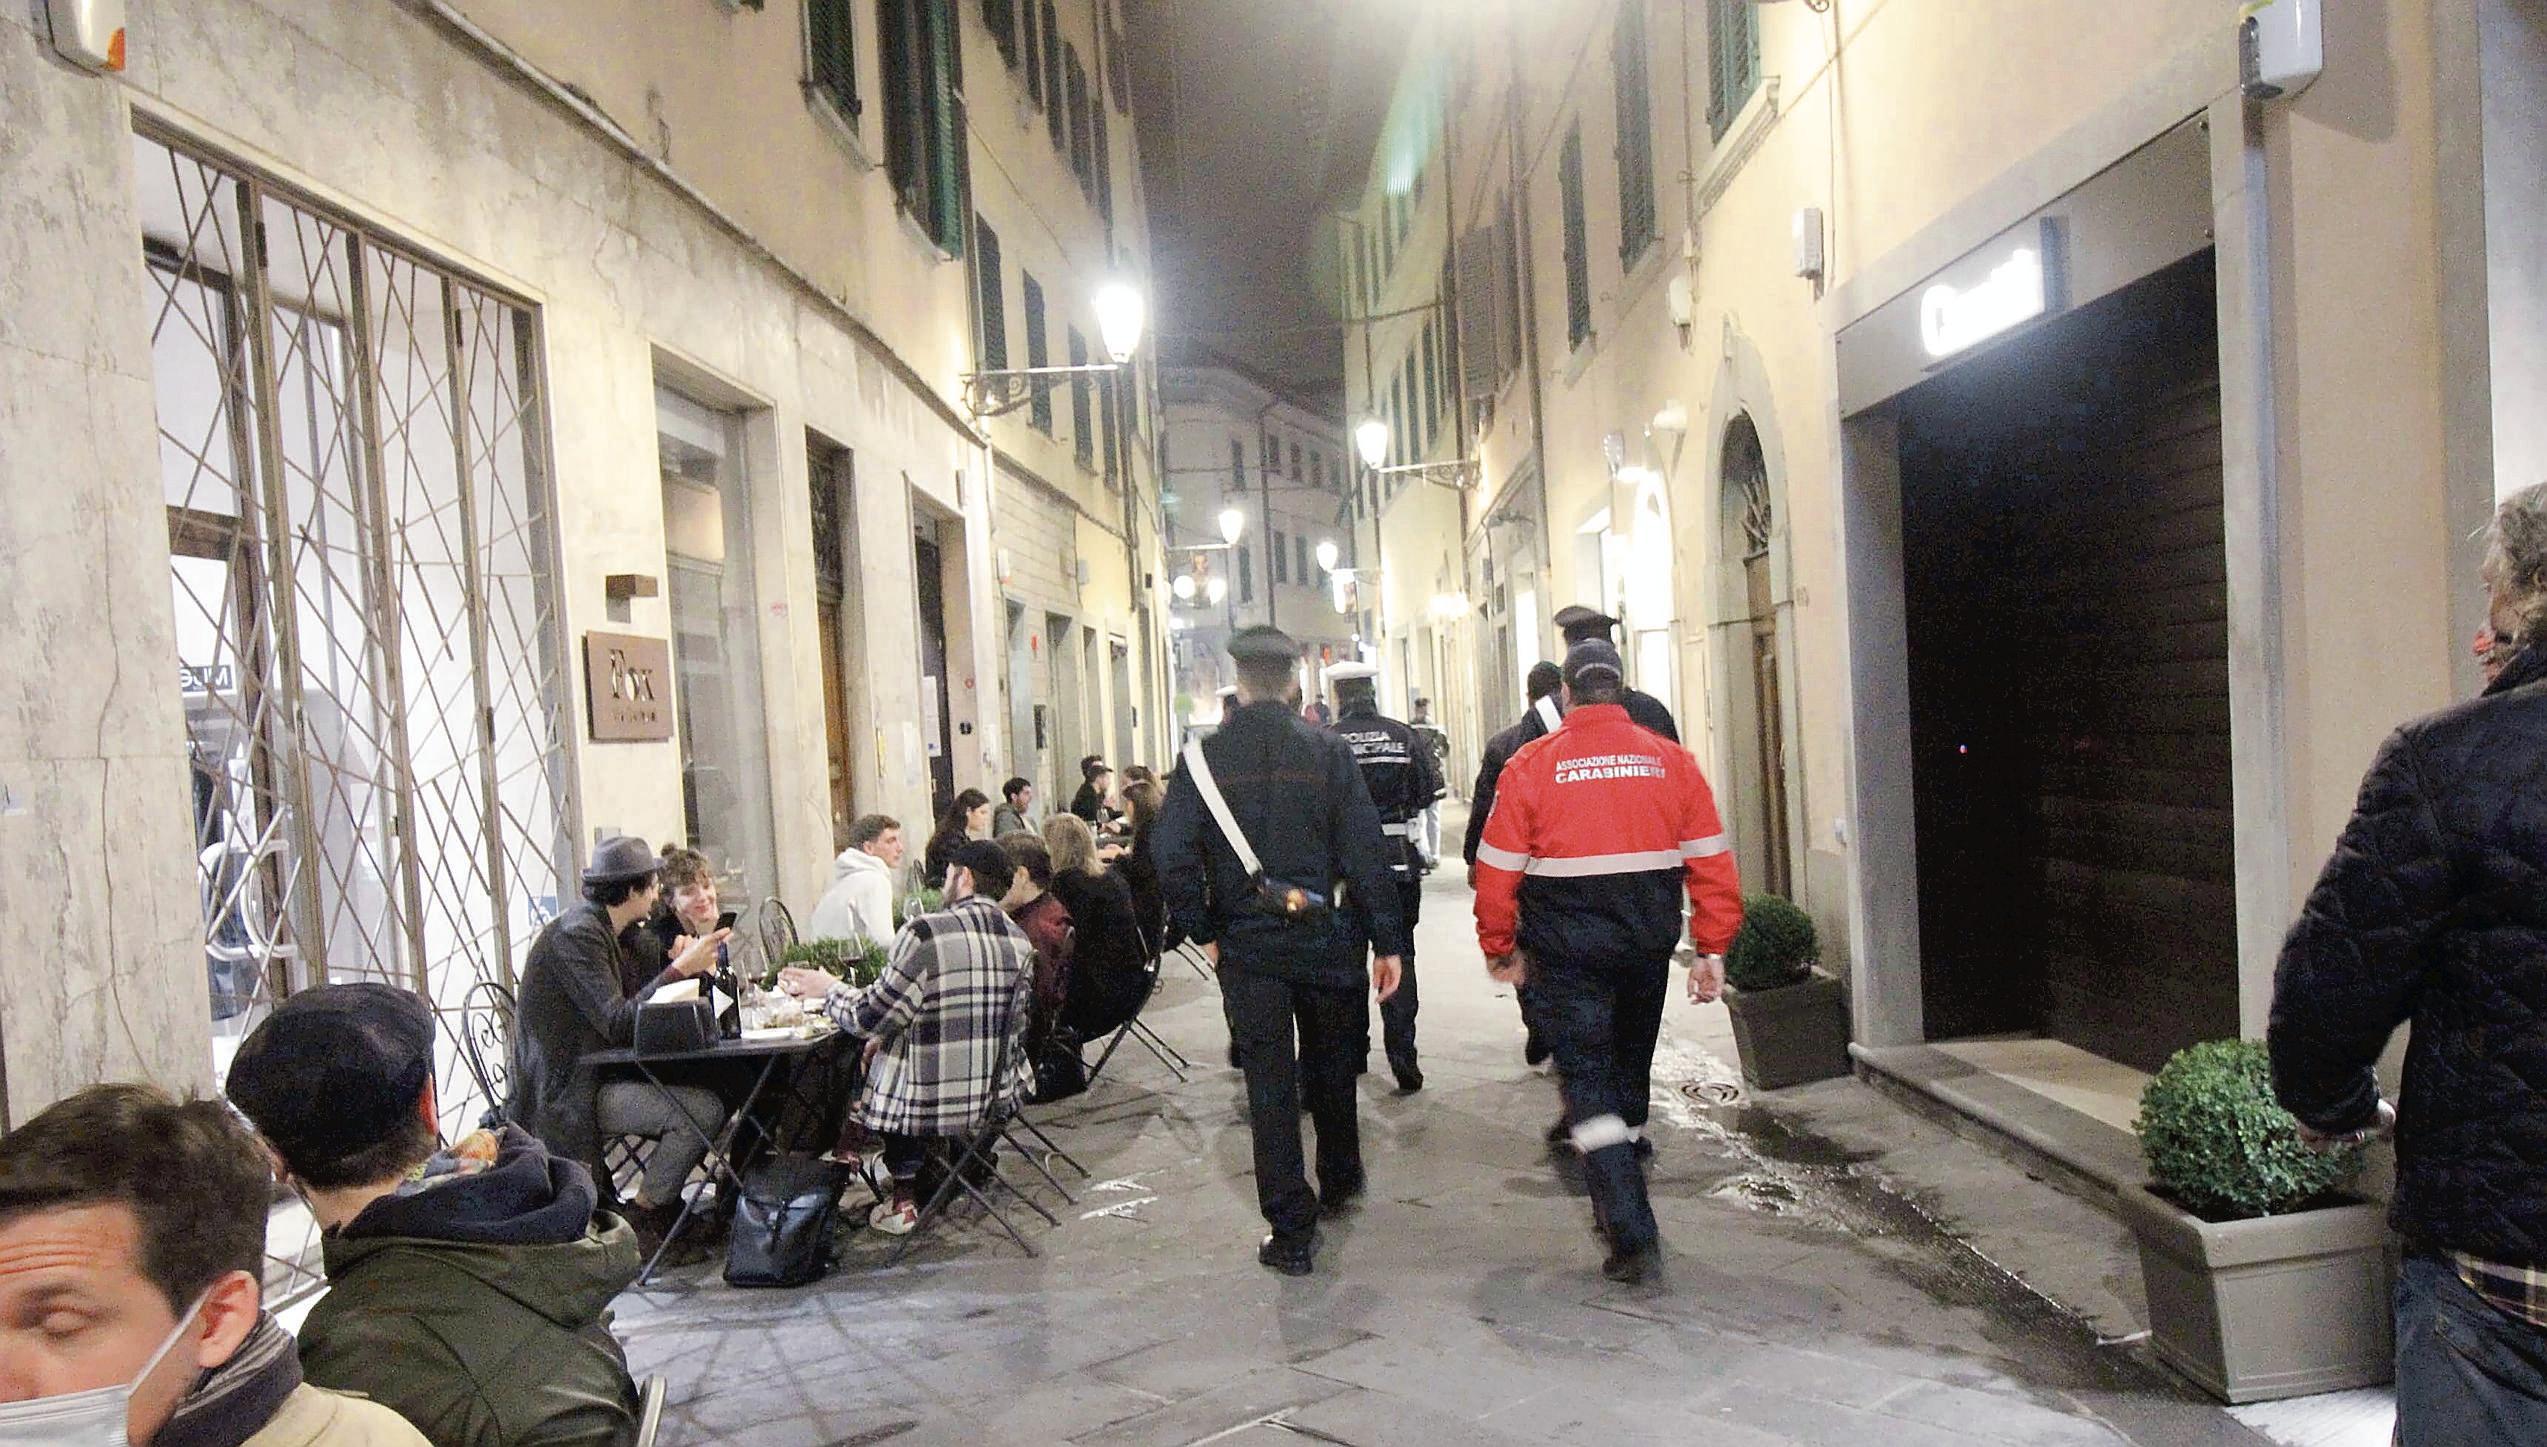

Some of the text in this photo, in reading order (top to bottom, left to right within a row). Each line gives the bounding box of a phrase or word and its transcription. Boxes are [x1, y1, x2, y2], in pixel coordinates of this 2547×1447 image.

[1556, 754, 1662, 771] ASSOCIAZIONE NAZIONALE
[1555, 765, 1665, 784] CARABINIERI
